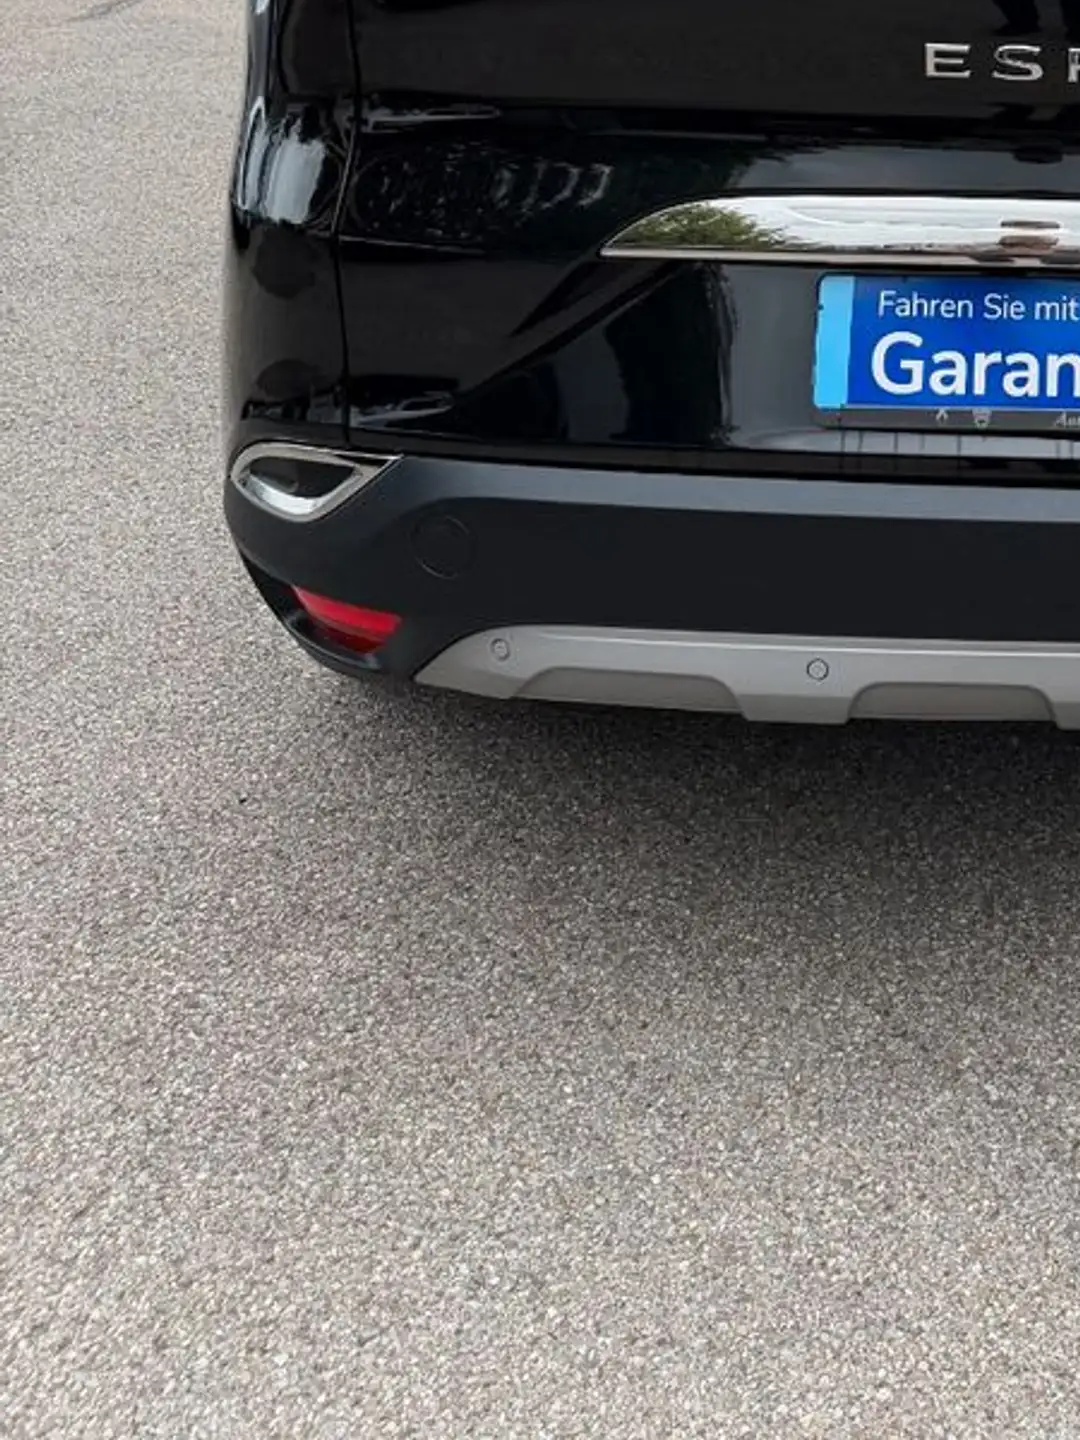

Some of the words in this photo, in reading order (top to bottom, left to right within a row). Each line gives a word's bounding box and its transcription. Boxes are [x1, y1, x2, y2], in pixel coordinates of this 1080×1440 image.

[878, 289, 974, 318] Fahren
[984, 292, 1026, 320] Sie
[1034, 295, 1080, 322] mit
